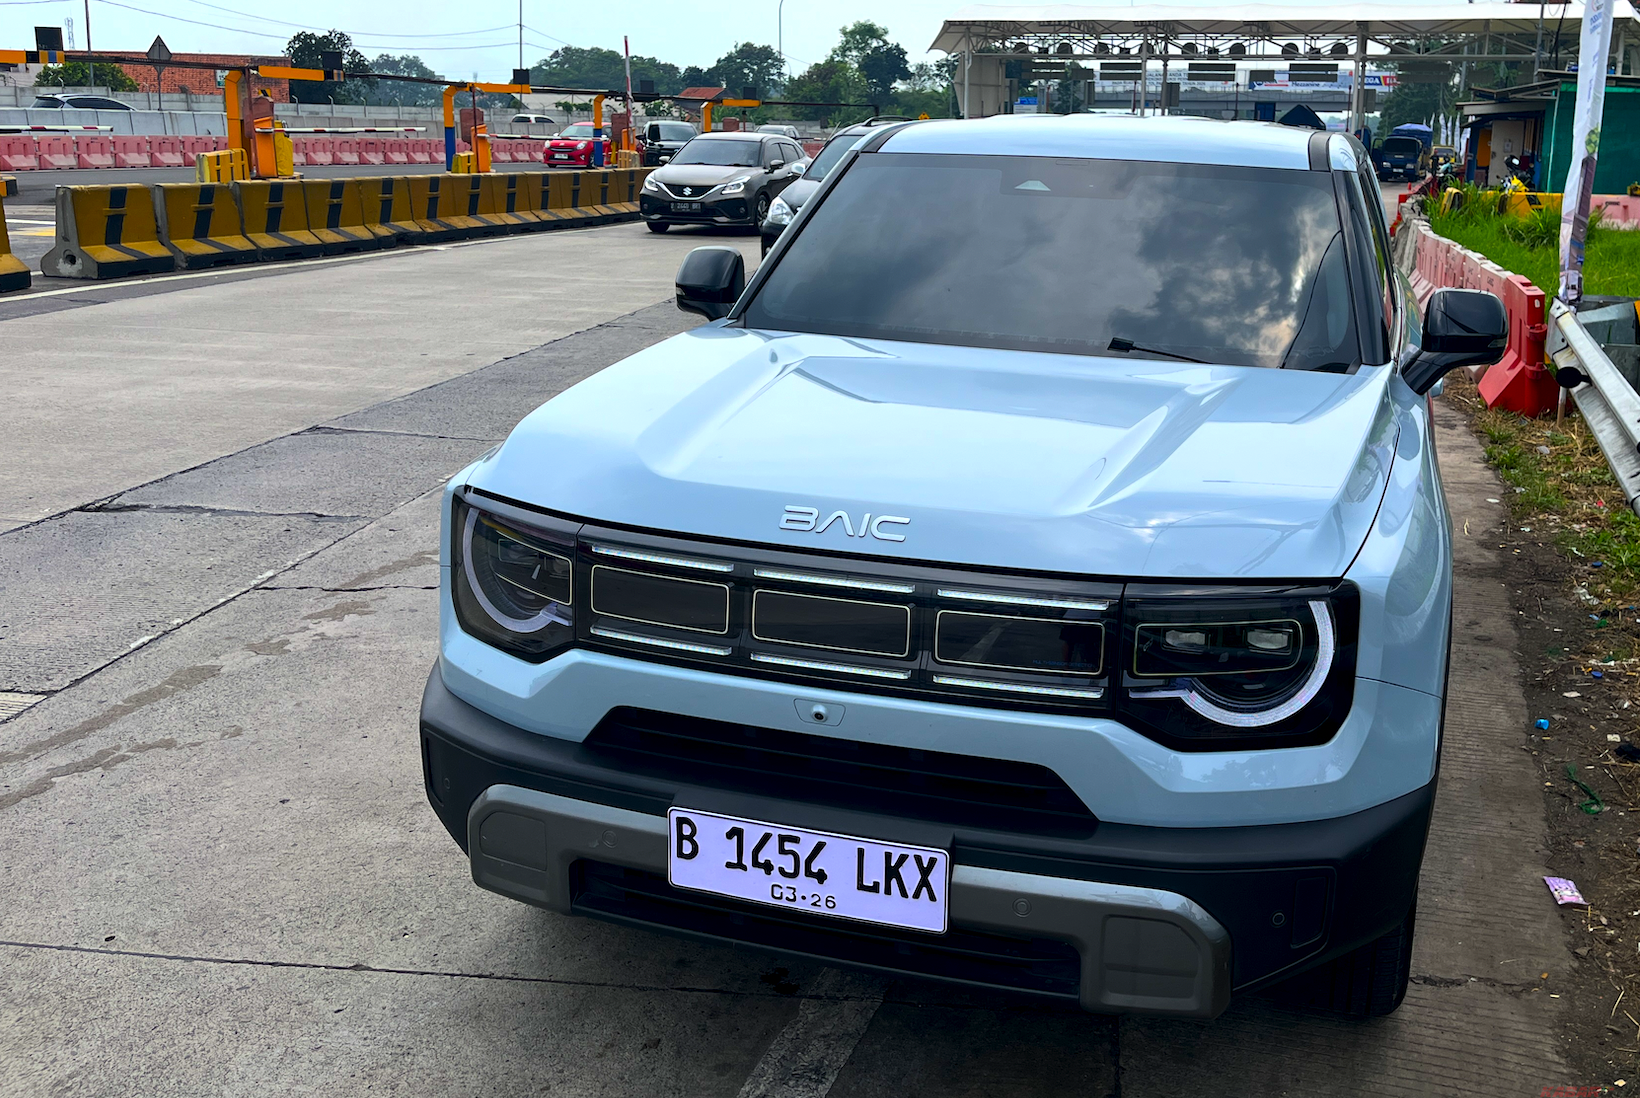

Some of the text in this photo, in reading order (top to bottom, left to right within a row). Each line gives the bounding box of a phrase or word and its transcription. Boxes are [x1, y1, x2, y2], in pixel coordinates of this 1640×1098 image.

[778, 504, 912, 543] BAIC
[675, 816, 938, 902] B 1454 LKX
